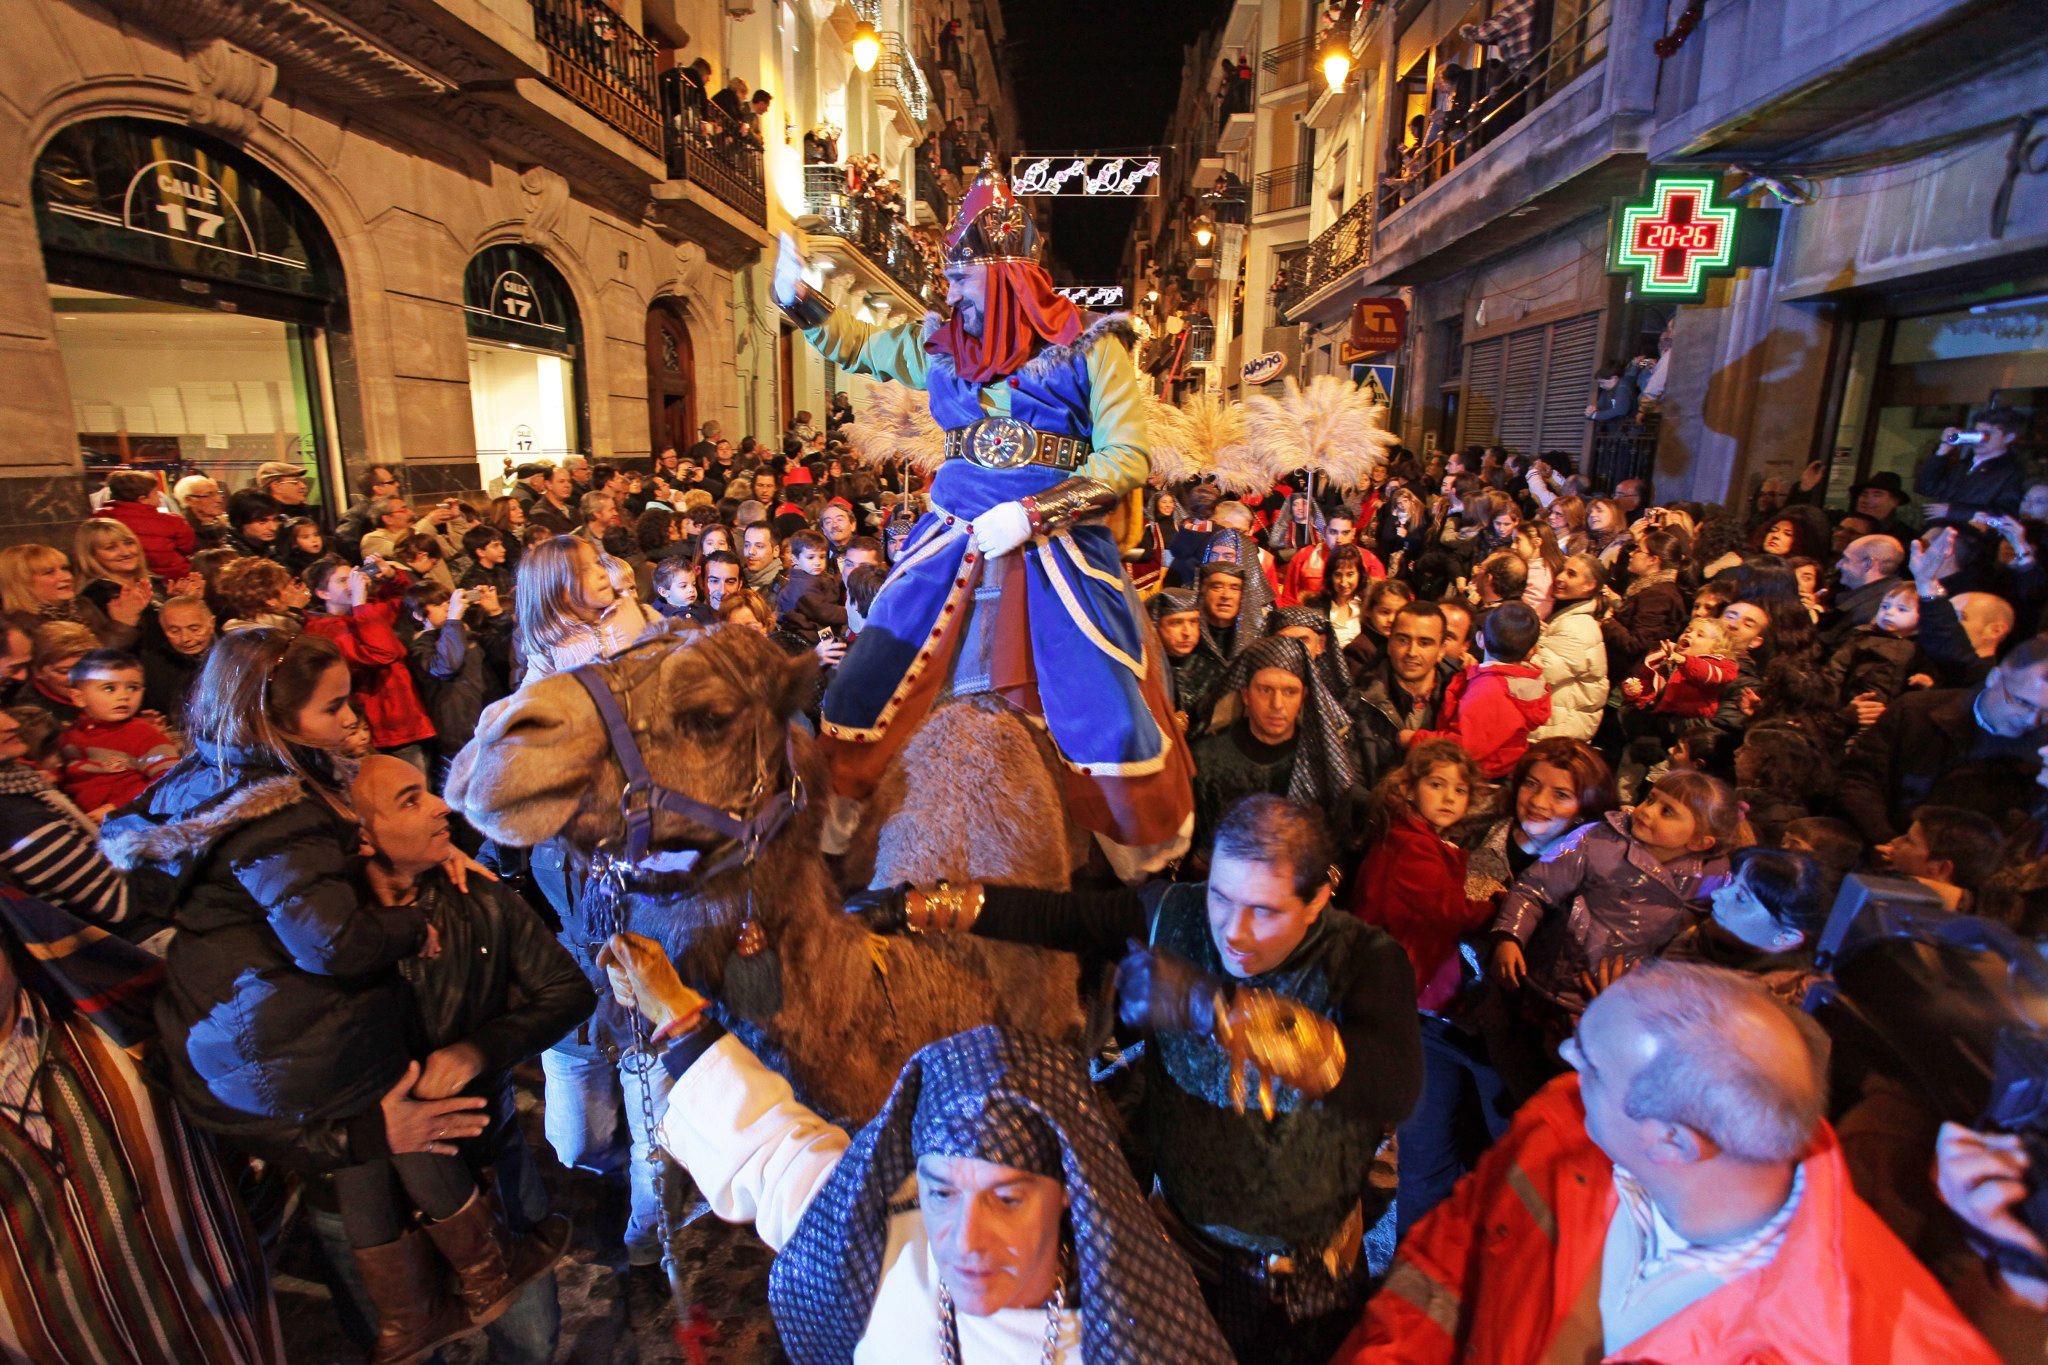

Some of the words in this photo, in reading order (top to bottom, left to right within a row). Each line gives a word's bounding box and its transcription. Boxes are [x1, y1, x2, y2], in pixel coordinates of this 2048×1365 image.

[157, 174, 219, 206] CALLE
[155, 203, 225, 239] 17
[1646, 225, 1707, 247] 20:26
[502, 297, 532, 318] 17
[517, 440, 532, 451] 17
